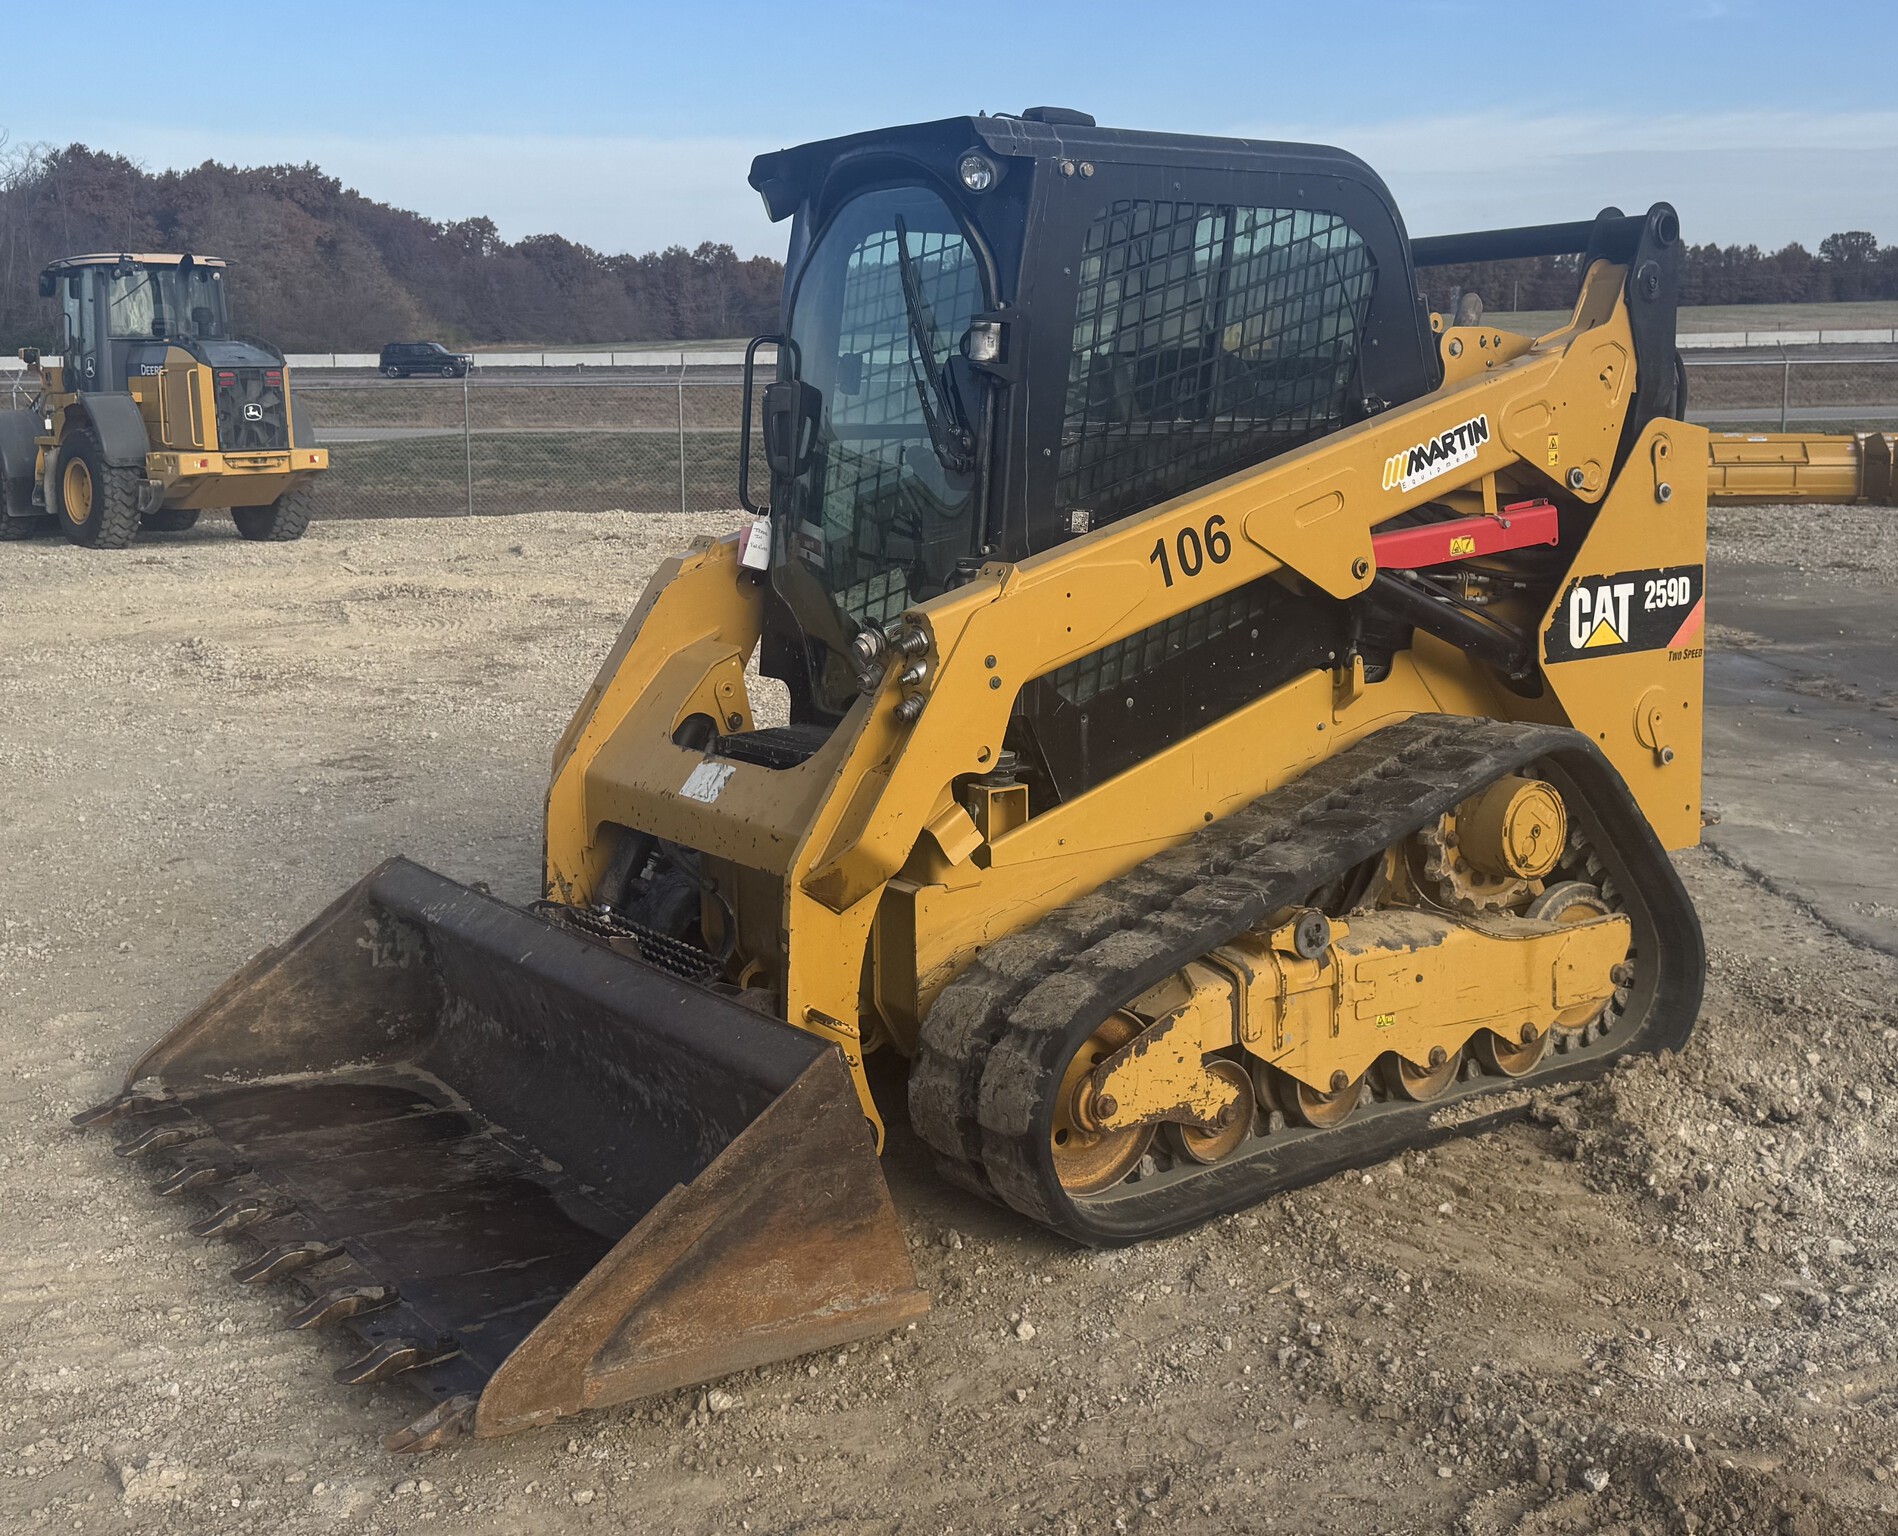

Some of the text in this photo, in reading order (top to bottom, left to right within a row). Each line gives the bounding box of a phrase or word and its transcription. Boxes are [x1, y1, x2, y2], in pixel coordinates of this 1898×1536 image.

[1406, 416, 1488, 477] MARTIN
[1149, 514, 1232, 588] 106
[1569, 576, 1691, 649] CAT 259D
